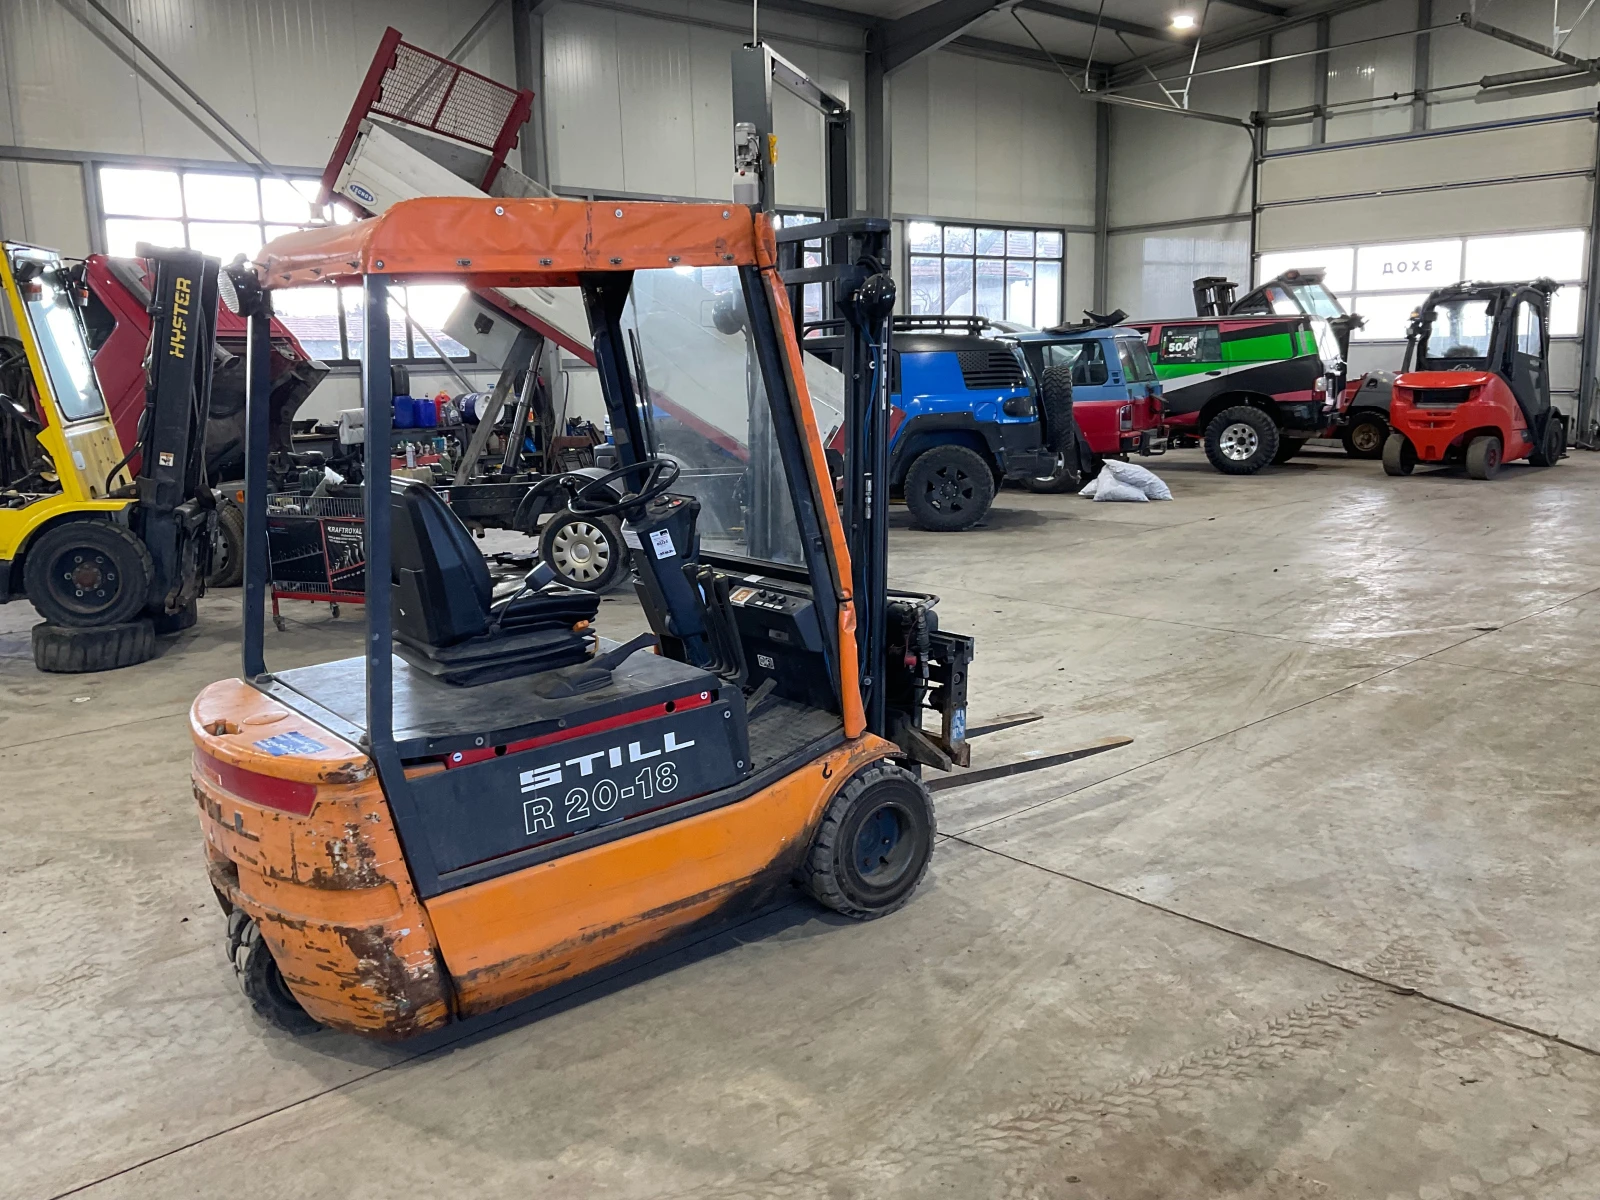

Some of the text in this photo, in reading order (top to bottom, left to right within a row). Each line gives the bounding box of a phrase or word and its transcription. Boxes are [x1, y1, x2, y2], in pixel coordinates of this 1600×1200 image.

[170, 277, 192, 359] HYSTER
[1168, 342, 1190, 352] 504
[327, 526, 362, 535] KRAFTROYAL
[519, 731, 695, 793] STILL
[523, 761, 679, 835] R 20-18
